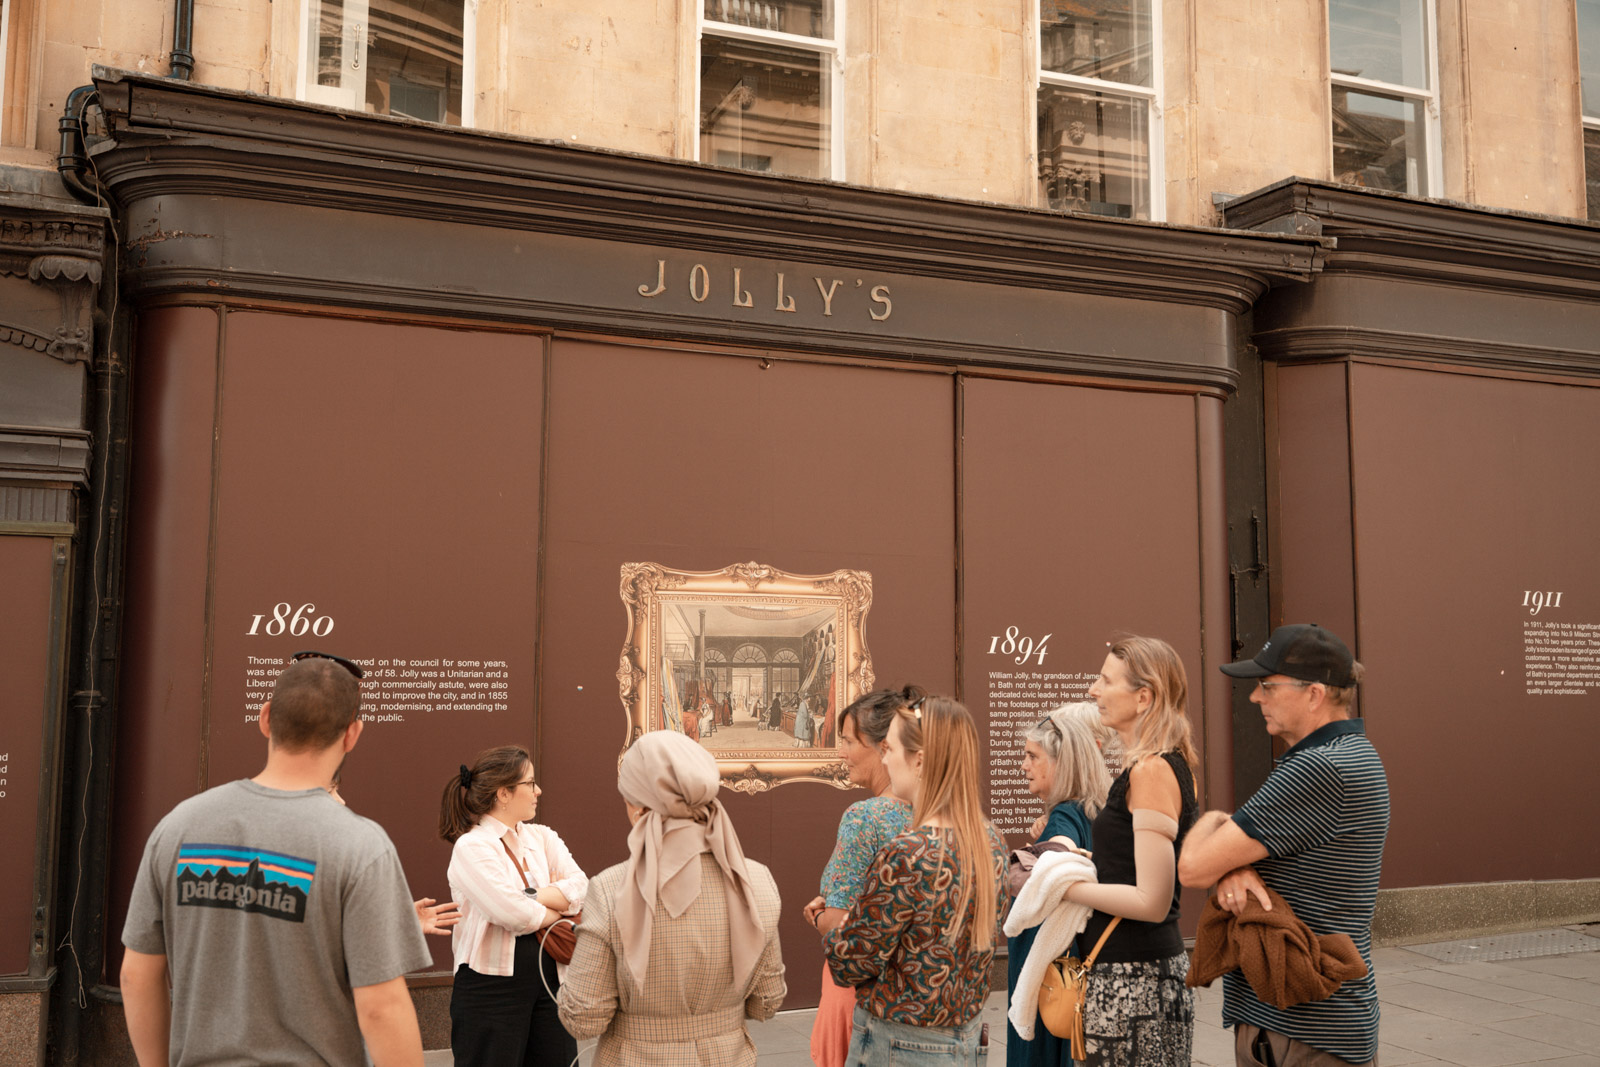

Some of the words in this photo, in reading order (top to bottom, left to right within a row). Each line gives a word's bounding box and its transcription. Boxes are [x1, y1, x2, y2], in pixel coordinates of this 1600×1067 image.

[638, 260, 892, 321] JOLLY'S
[1521, 590, 1564, 616] 1911
[245, 602, 334, 637] 1860
[986, 626, 1052, 666] 1894
[248, 656, 283, 665] Thomas
[351, 657, 374, 666] erved
[392, 658, 406, 666] the
[410, 658, 439, 666] council
[442, 658, 454, 667] for
[483, 660, 508, 669] years,
[362, 670, 372, 679] ge
[374, 668, 383, 677] of
[385, 668, 398, 677] 58.
[400, 668, 419, 679] Jolly
[447, 669, 484, 677] Unitarian
[485, 669, 501, 678] and
[1014, 672, 1030, 681] Jolly,
[1043, 672, 1073, 681] grandson
[246, 679, 276, 687] Liberal
[359, 679, 380, 690] ough
[382, 679, 436, 690] commercially
[439, 680, 466, 690] astute,
[491, 680, 508, 689] also
[1028, 681, 1042, 690] only
[246, 692, 265, 701] very
[361, 690, 380, 699] nted
[382, 690, 390, 699] to
[392, 690, 426, 701] improve
[428, 690, 441, 699] the
[443, 691, 459, 701] city,
[460, 691, 476, 699] and
[478, 691, 485, 699] in
[488, 691, 508, 699] 1855
[380, 702, 434, 712] modernising,
[436, 702, 451, 710] and
[453, 702, 493, 712] extending
[495, 702, 508, 710] the
[1010, 700, 1039, 710] footsteps
[361, 712, 375, 721] the
[377, 712, 405, 723] public.
[1009, 710, 1035, 719] position.
[989, 719, 1014, 729] already
[1002, 729, 1013, 738] city
[990, 739, 1012, 748] During
[990, 748, 1021, 758] important
[1009, 768, 1025, 777] city's
[990, 777, 1030, 787] spearheade
[990, 787, 1012, 797] supply
[990, 807, 1013, 816] During
[1028, 806, 1044, 815] time,
[181, 878, 296, 914] patagonia
